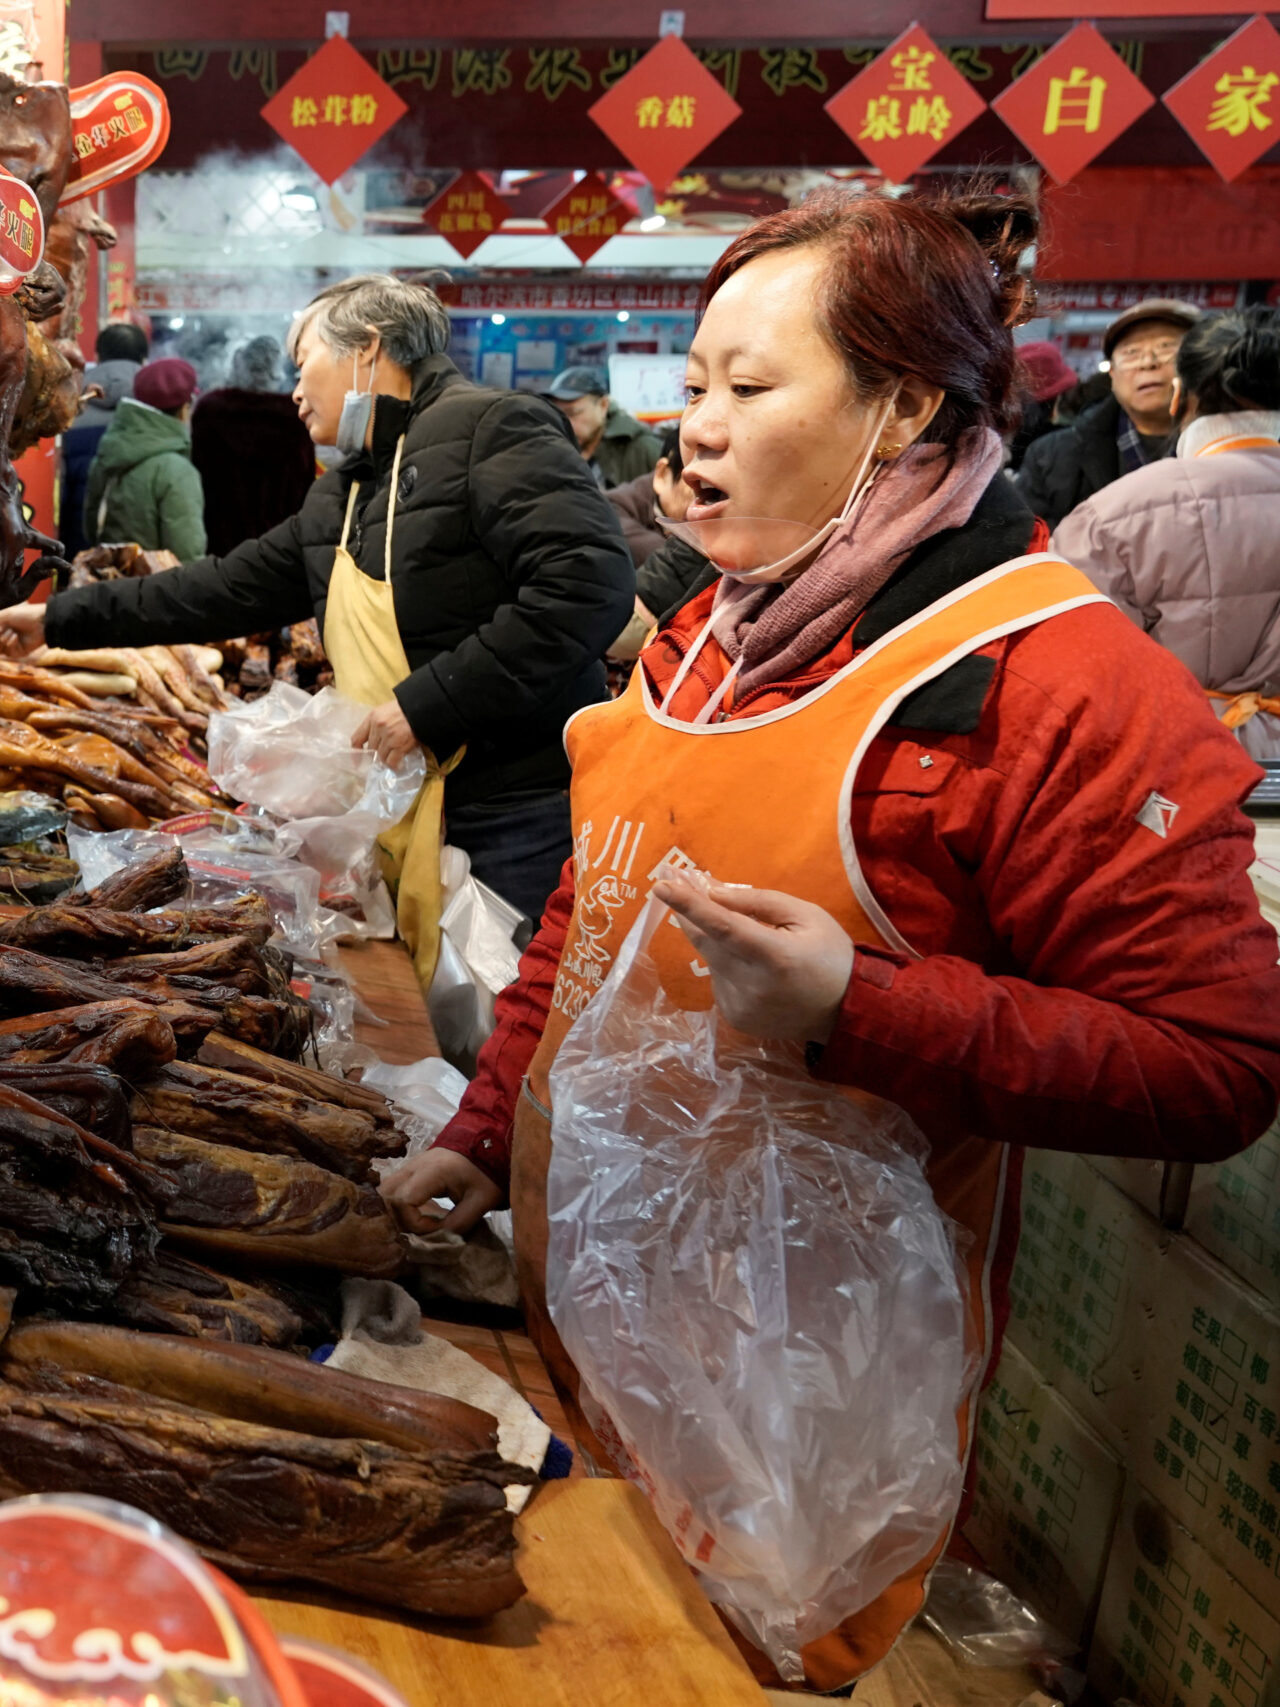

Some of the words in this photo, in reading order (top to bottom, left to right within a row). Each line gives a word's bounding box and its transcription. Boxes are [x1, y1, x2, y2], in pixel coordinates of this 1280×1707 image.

[888, 46, 935, 91] 宝
[291, 94, 378, 127] 松茸粉
[635, 95, 696, 128] 香菇
[859, 95, 953, 142] 泉岭
[1043, 67, 1107, 135] 白
[1206, 67, 1279, 137] 家
[72, 106, 148, 162] 金华火腿
[620, 883, 637, 900] TM
[1192, 1305, 1222, 1348] 芒果
